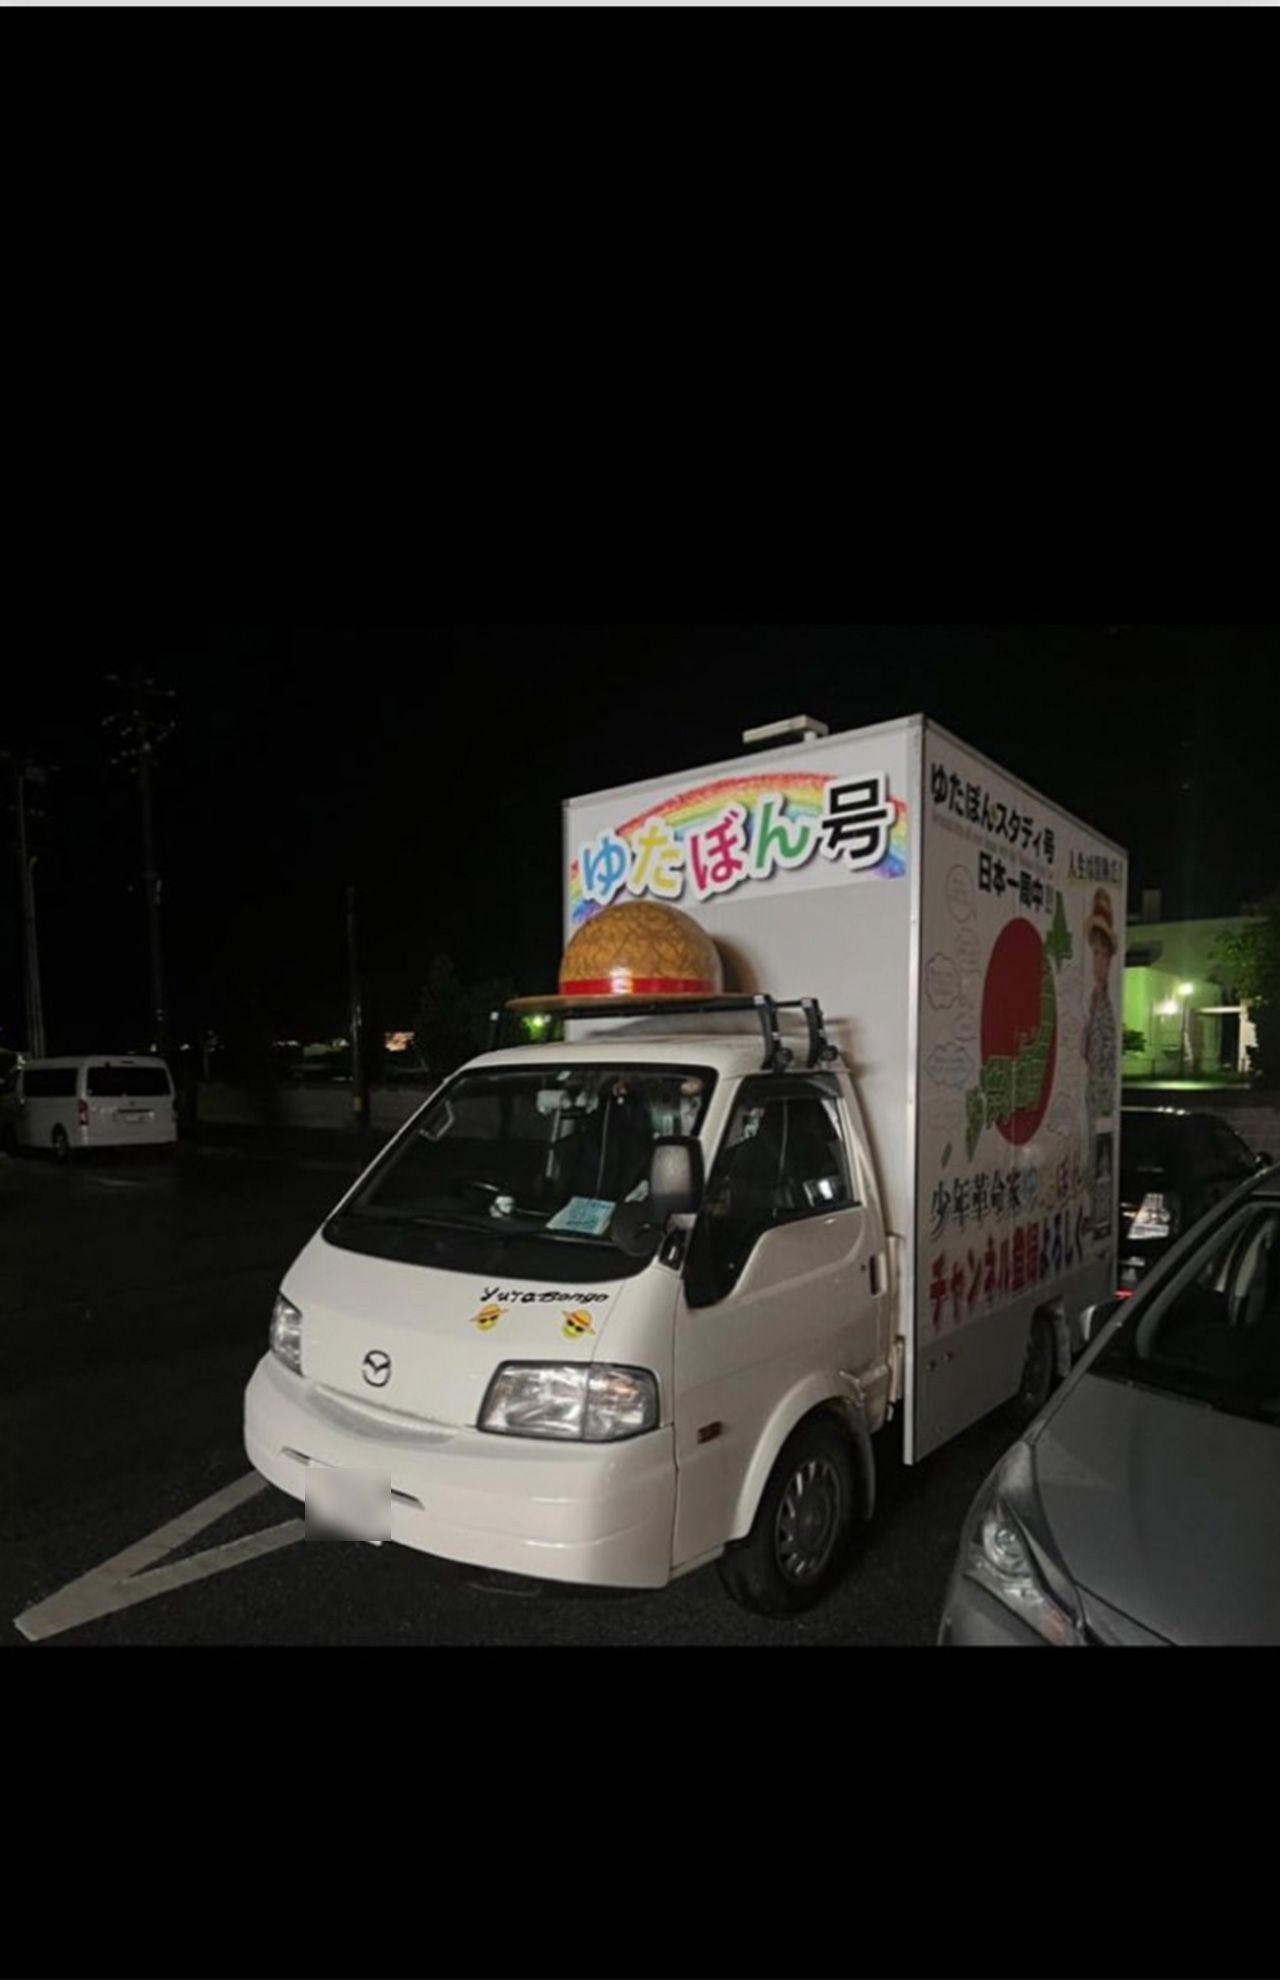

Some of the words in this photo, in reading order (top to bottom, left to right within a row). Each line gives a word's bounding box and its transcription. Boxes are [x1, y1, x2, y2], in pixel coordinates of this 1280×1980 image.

[582, 776, 889, 896] ゆたぼん号
